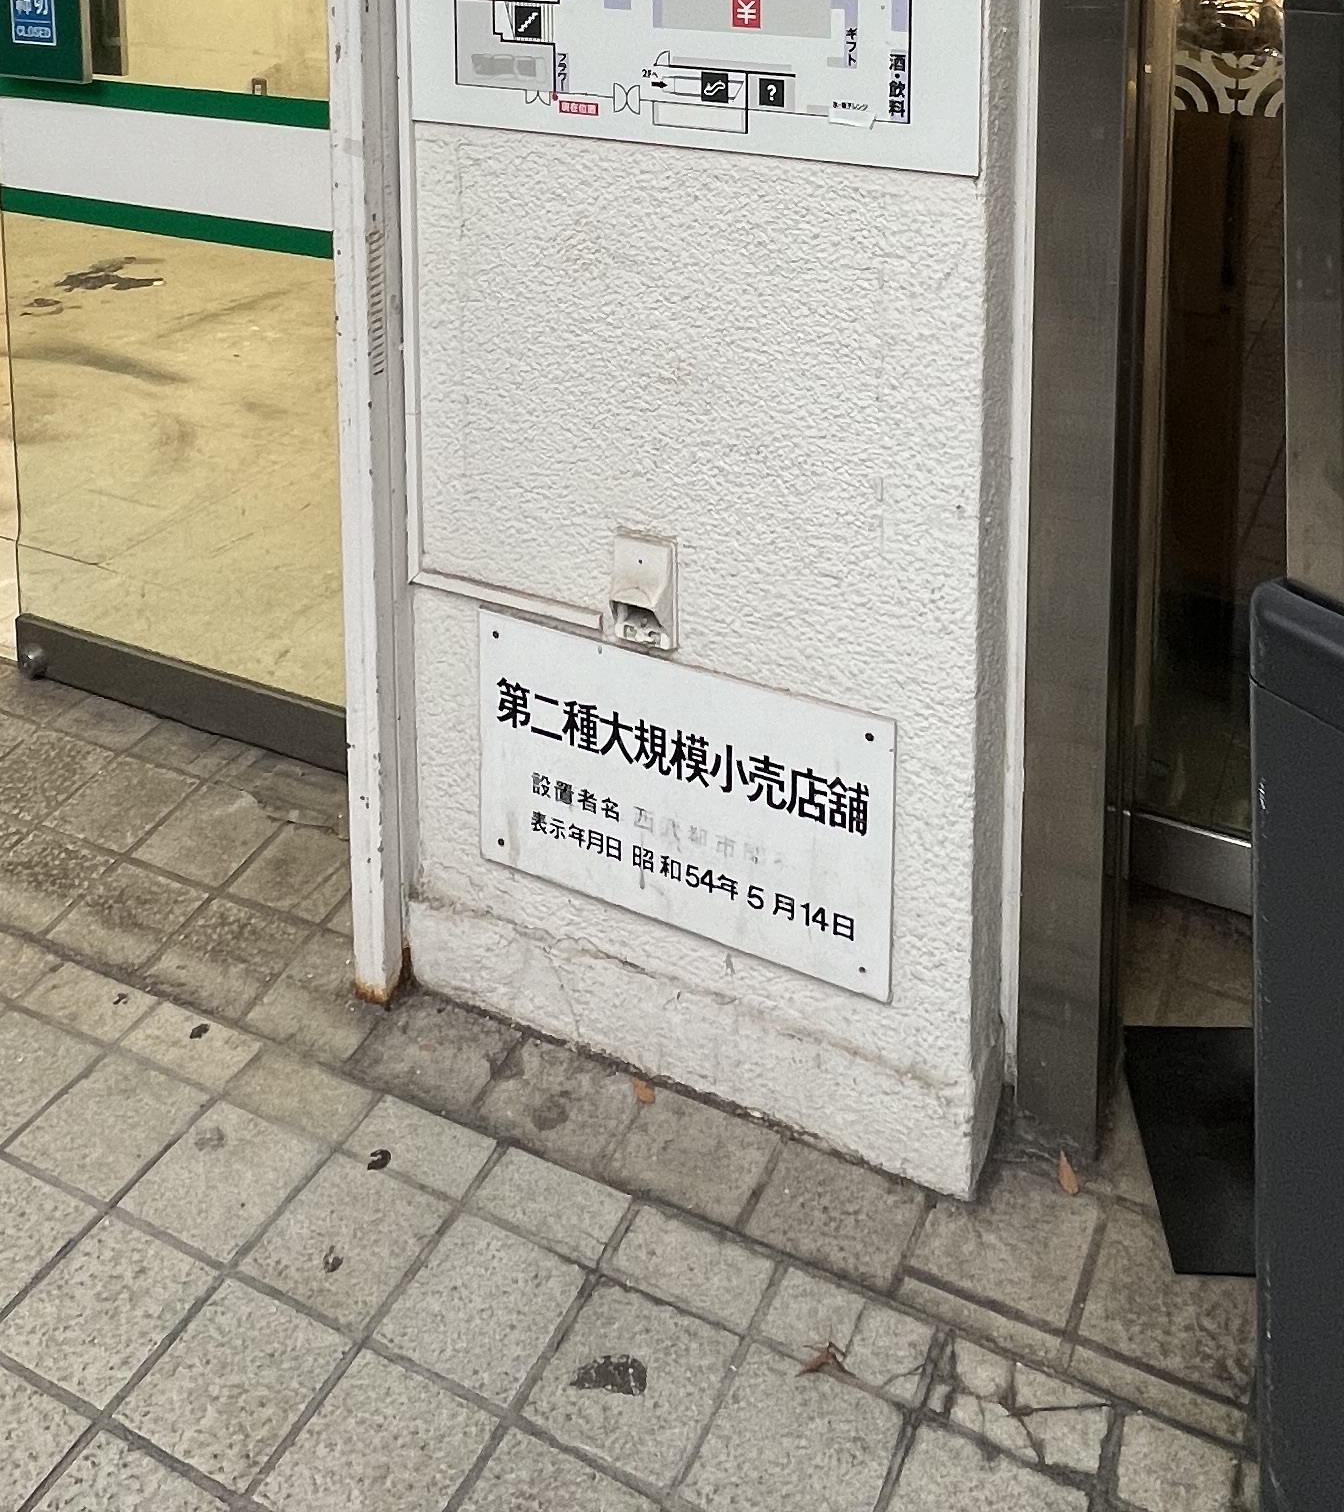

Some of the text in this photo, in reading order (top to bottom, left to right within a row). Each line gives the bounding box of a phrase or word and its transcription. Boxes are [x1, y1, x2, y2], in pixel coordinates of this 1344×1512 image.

[16, 25, 52, 39] CLOSED
[845, 27, 858, 67] ギフト
[888, 53, 906, 118] 酒・飲料
[496, 677, 869, 837] 第二種大規模小売店舗
[530, 771, 621, 824] 設置者名
[530, 810, 623, 862] 表示年月日
